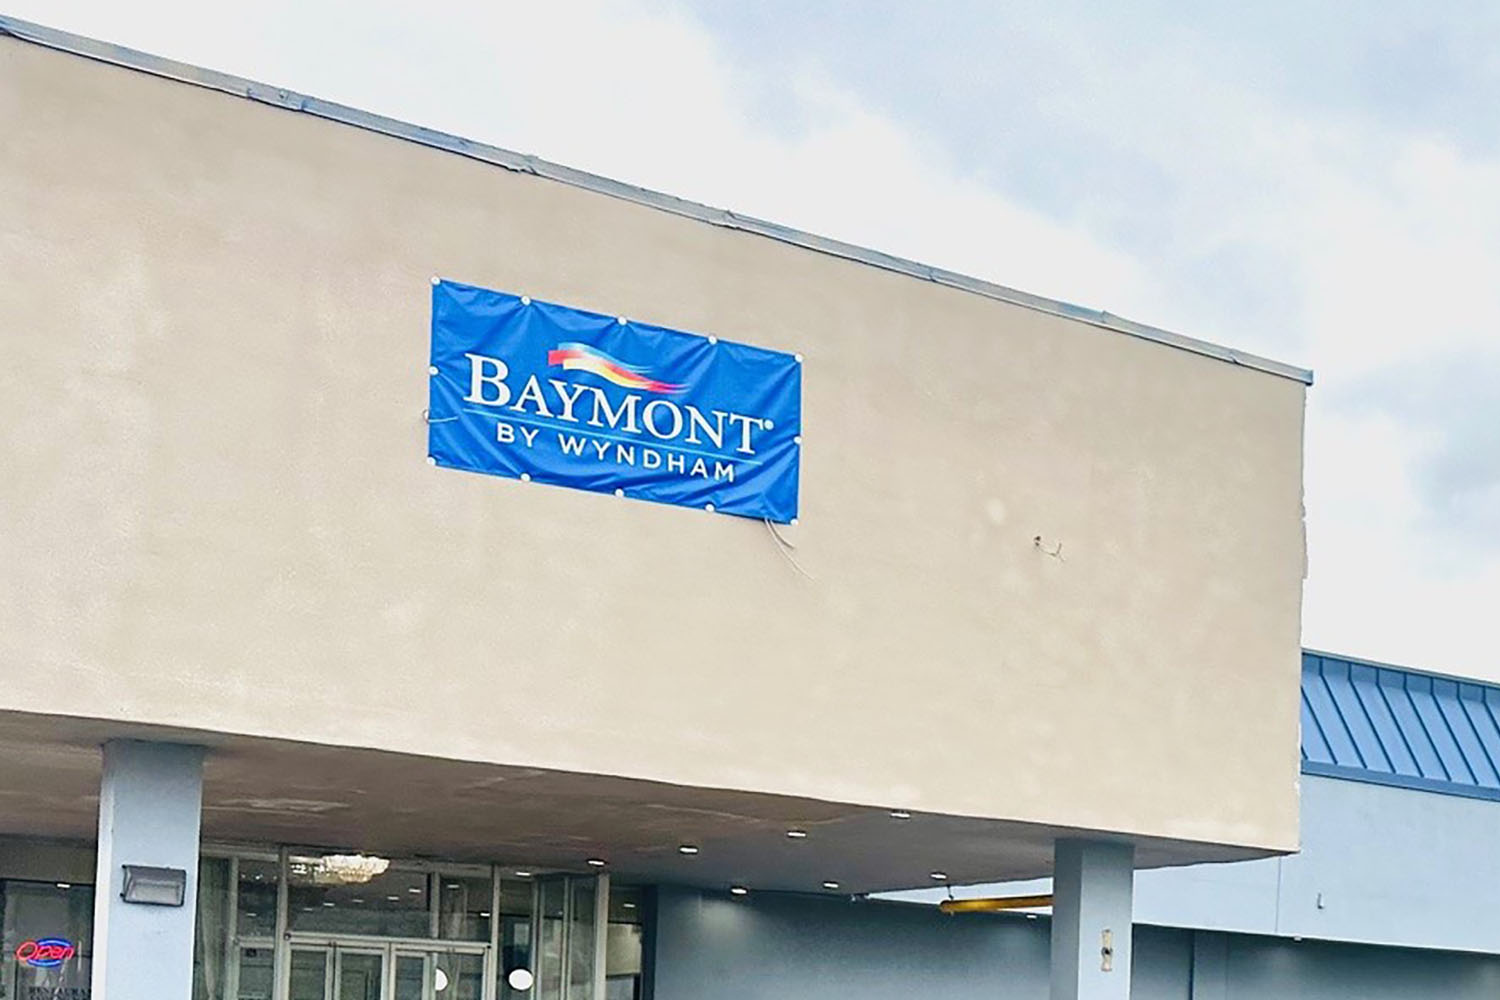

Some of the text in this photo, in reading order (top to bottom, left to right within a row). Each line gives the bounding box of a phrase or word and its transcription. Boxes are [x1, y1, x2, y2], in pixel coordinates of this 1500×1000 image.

[462, 352, 764, 455] BAYMONT
[496, 422, 735, 483] BY WYNDHAM
